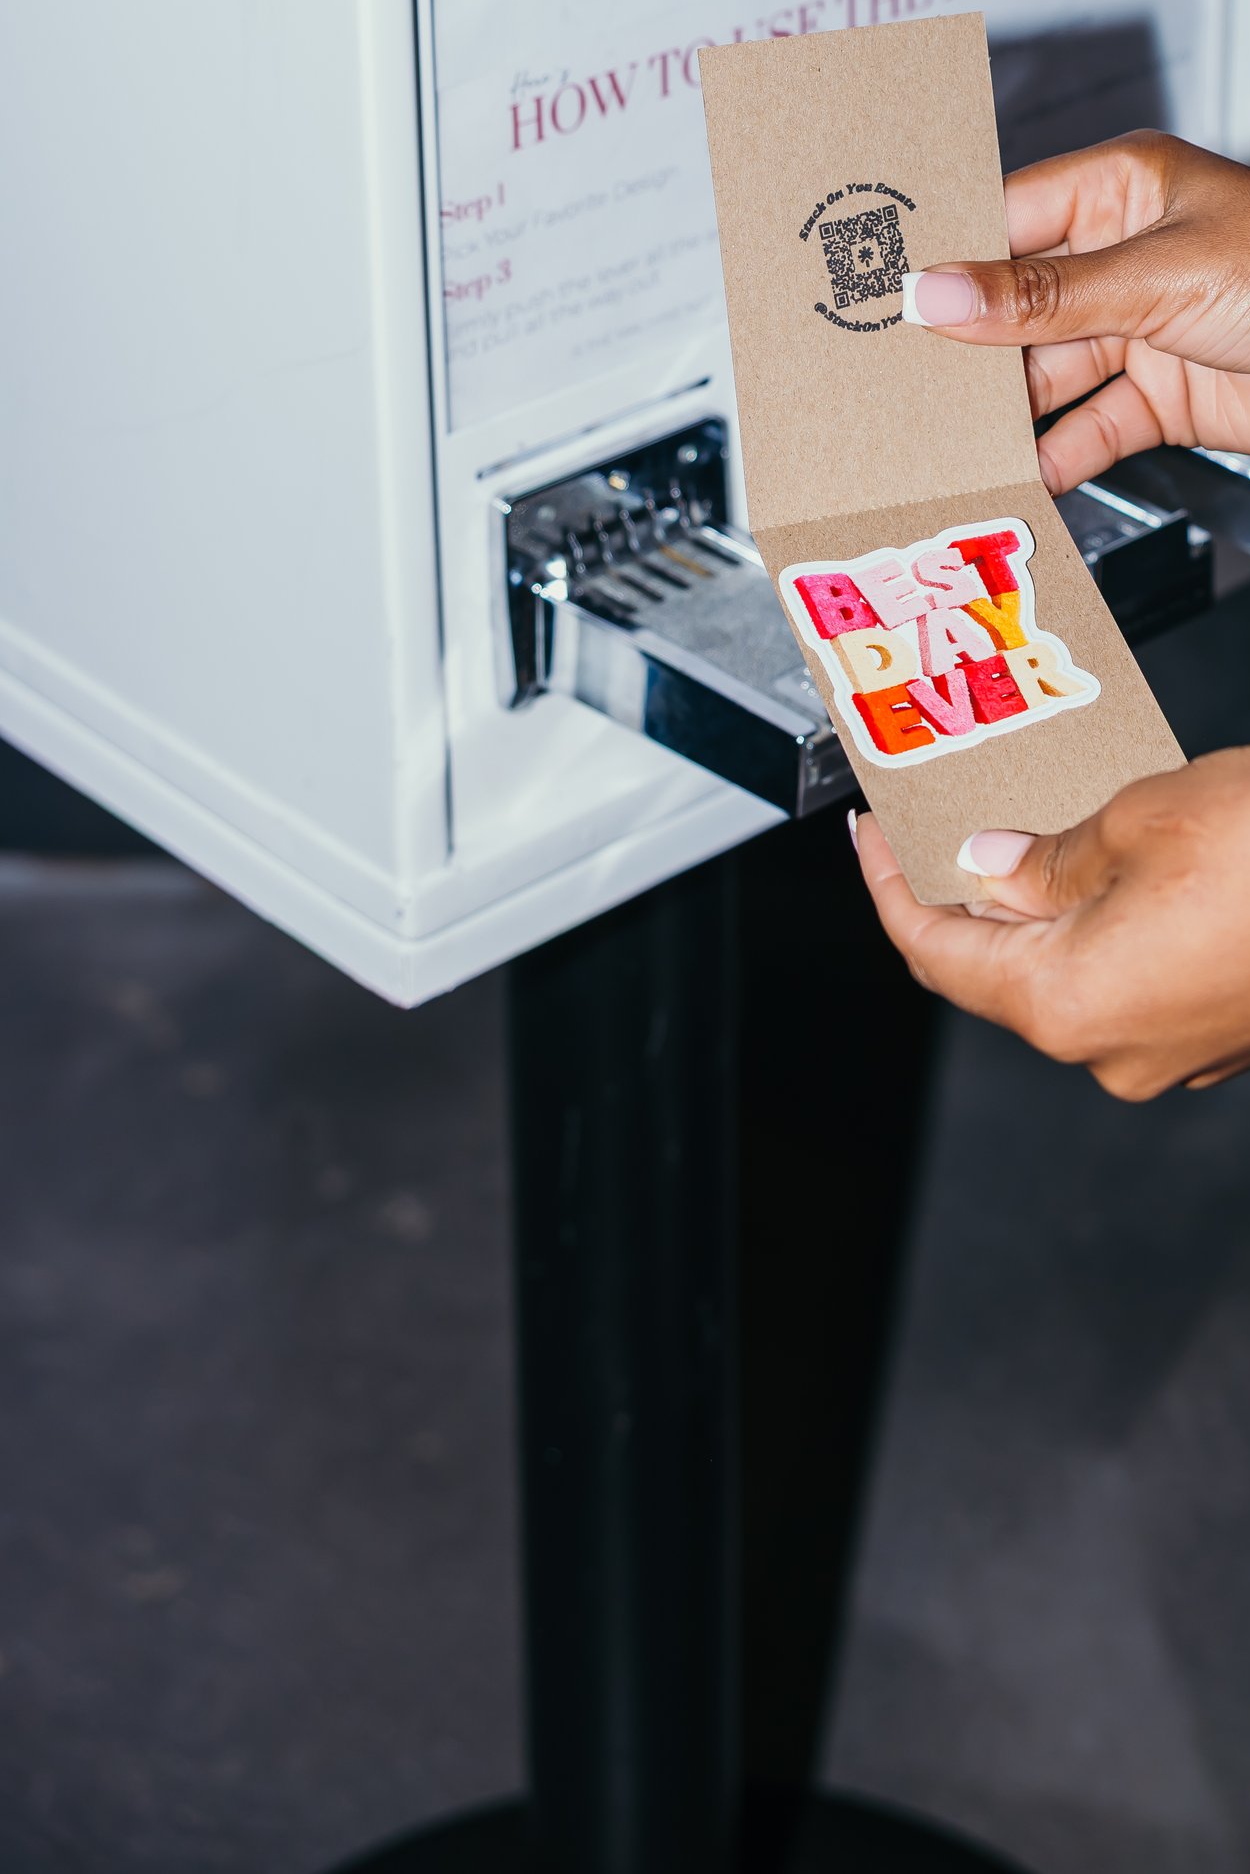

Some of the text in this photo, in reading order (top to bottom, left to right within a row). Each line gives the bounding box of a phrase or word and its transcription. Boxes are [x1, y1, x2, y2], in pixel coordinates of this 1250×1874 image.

[508, 61, 639, 152] HOW
[799, 182, 917, 242] Stuck On You Events
[793, 530, 1020, 640] BEST
[828, 590, 1029, 695] DAY
[852, 644, 1088, 756] EVER
